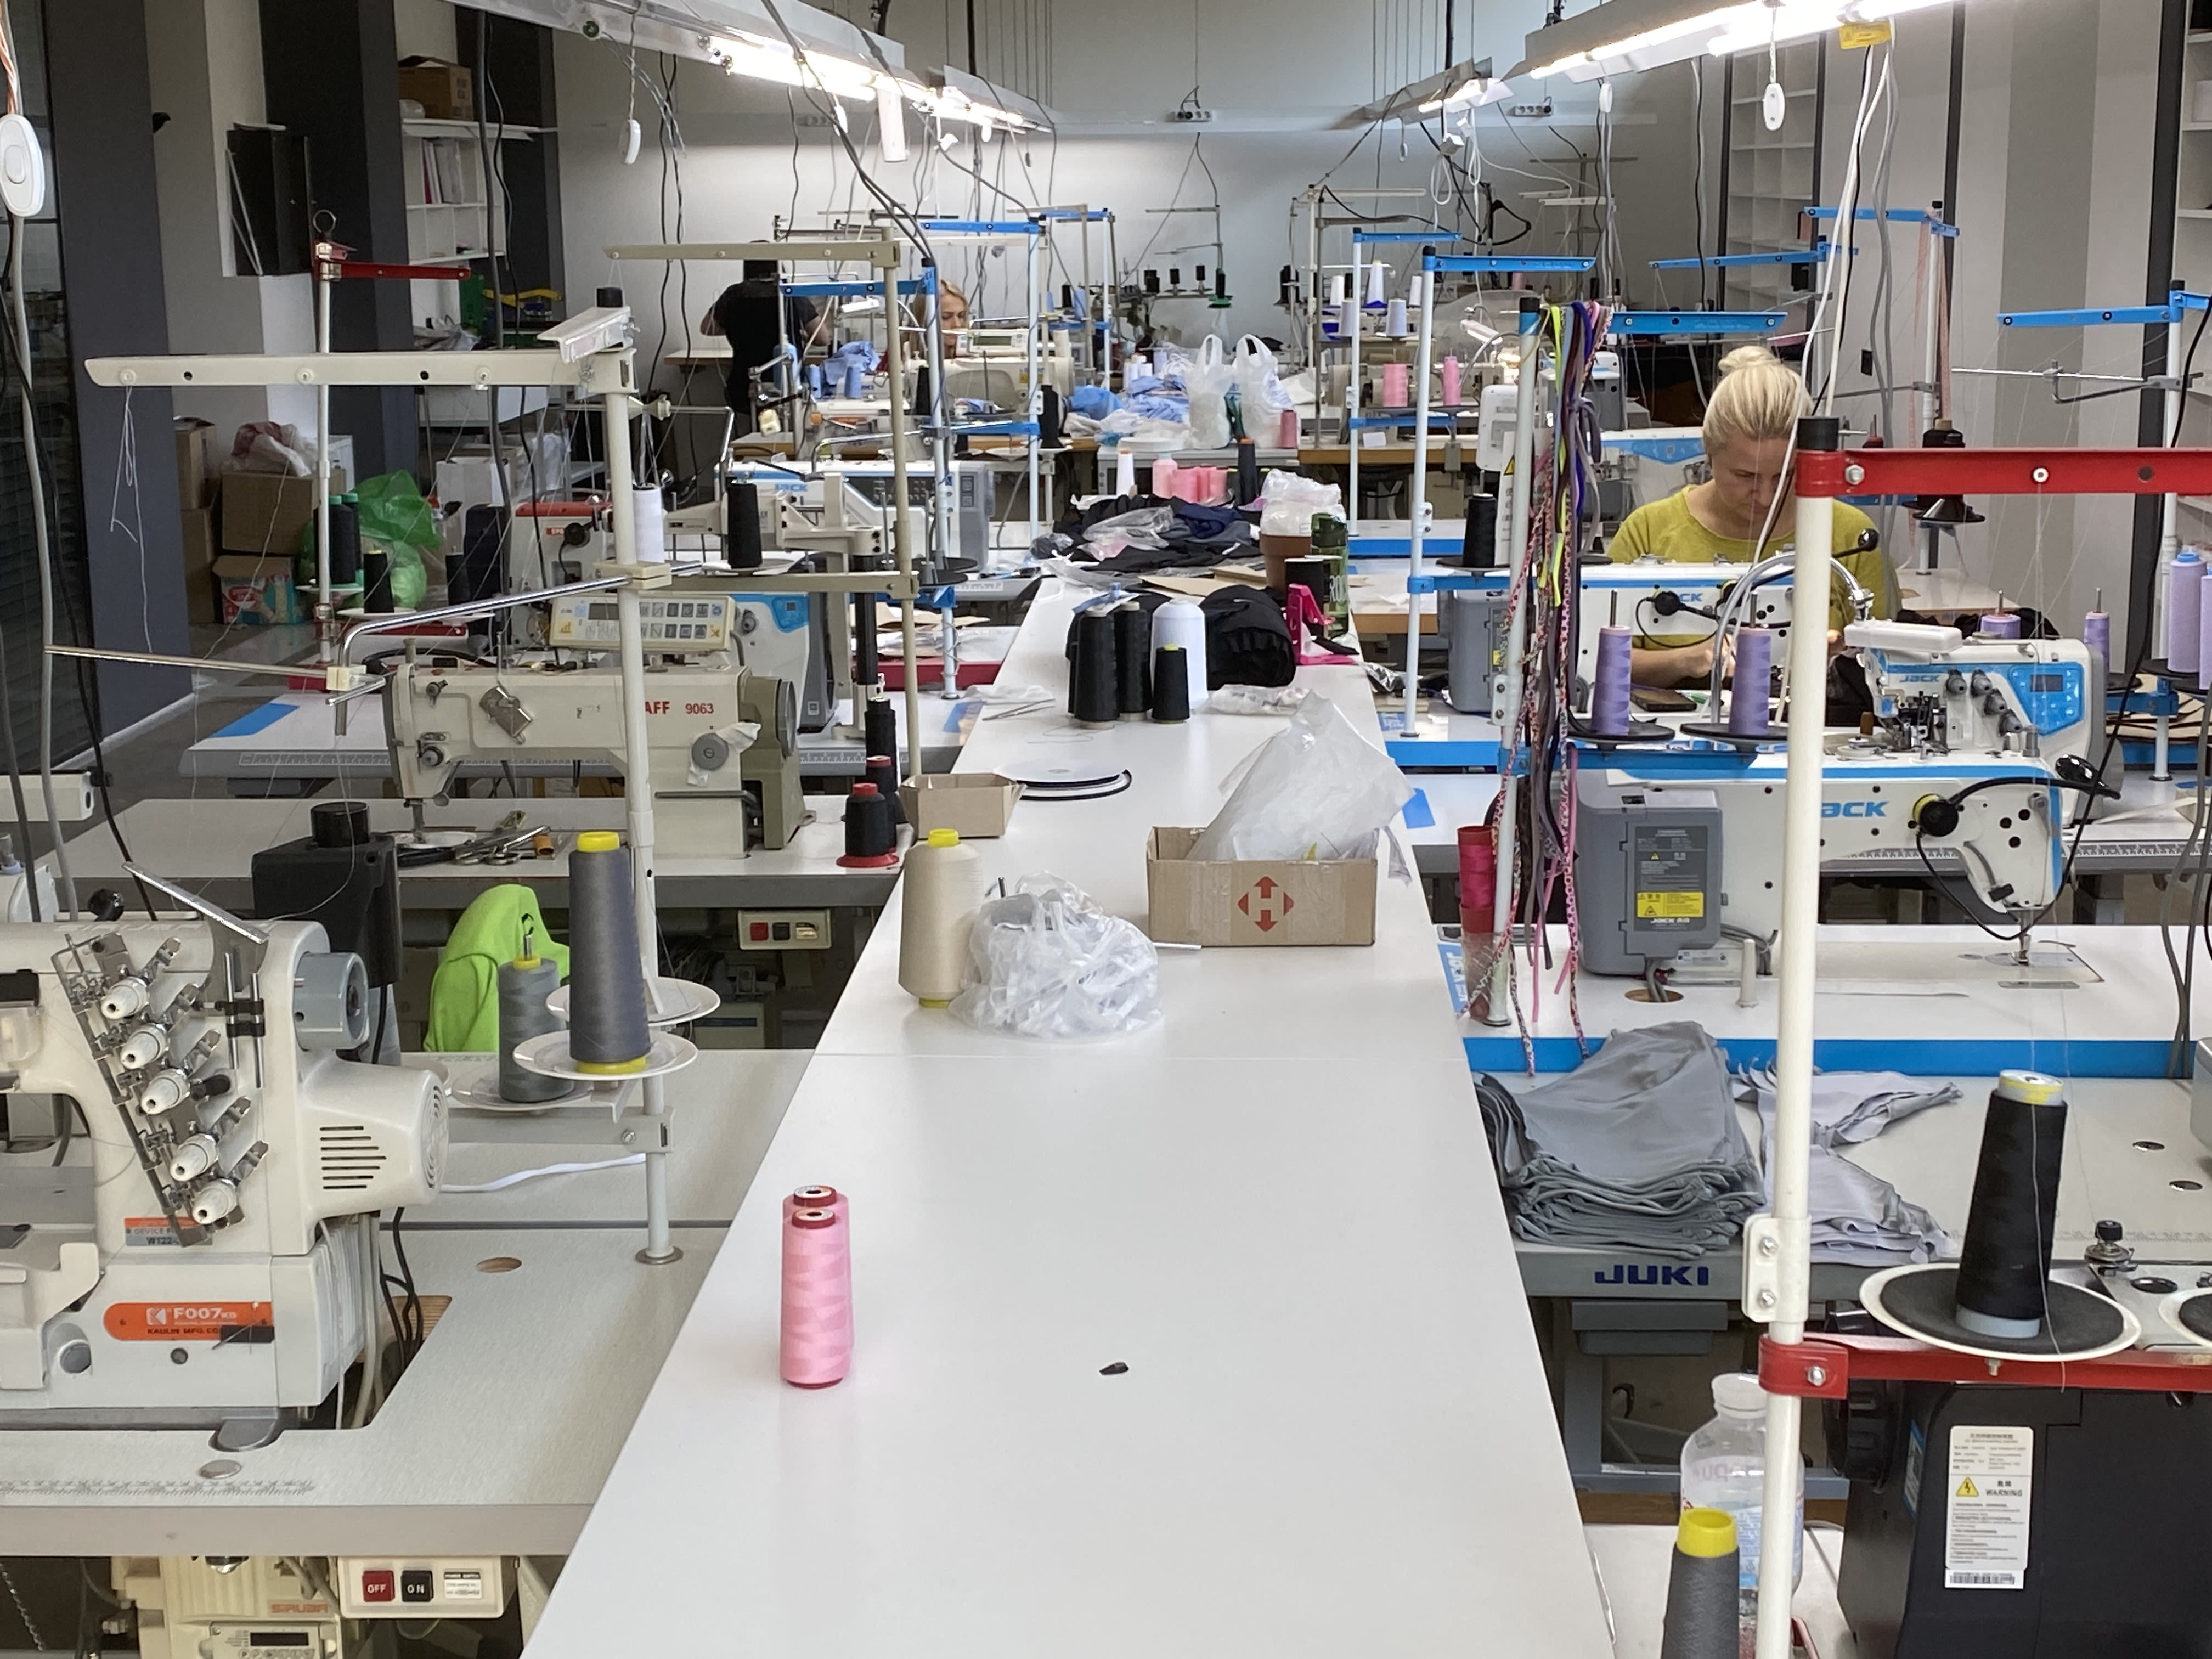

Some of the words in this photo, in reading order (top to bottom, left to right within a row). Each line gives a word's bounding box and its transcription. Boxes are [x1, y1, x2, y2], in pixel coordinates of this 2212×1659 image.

[1679, 593, 1703, 602] CK
[645, 701, 670, 714] AFF
[685, 703, 714, 714] 9063
[1821, 800, 1889, 817] ACK
[1594, 1264, 1709, 1286] JUKI
[368, 1585, 386, 1593] OFF
[408, 1585, 424, 1594] ON
